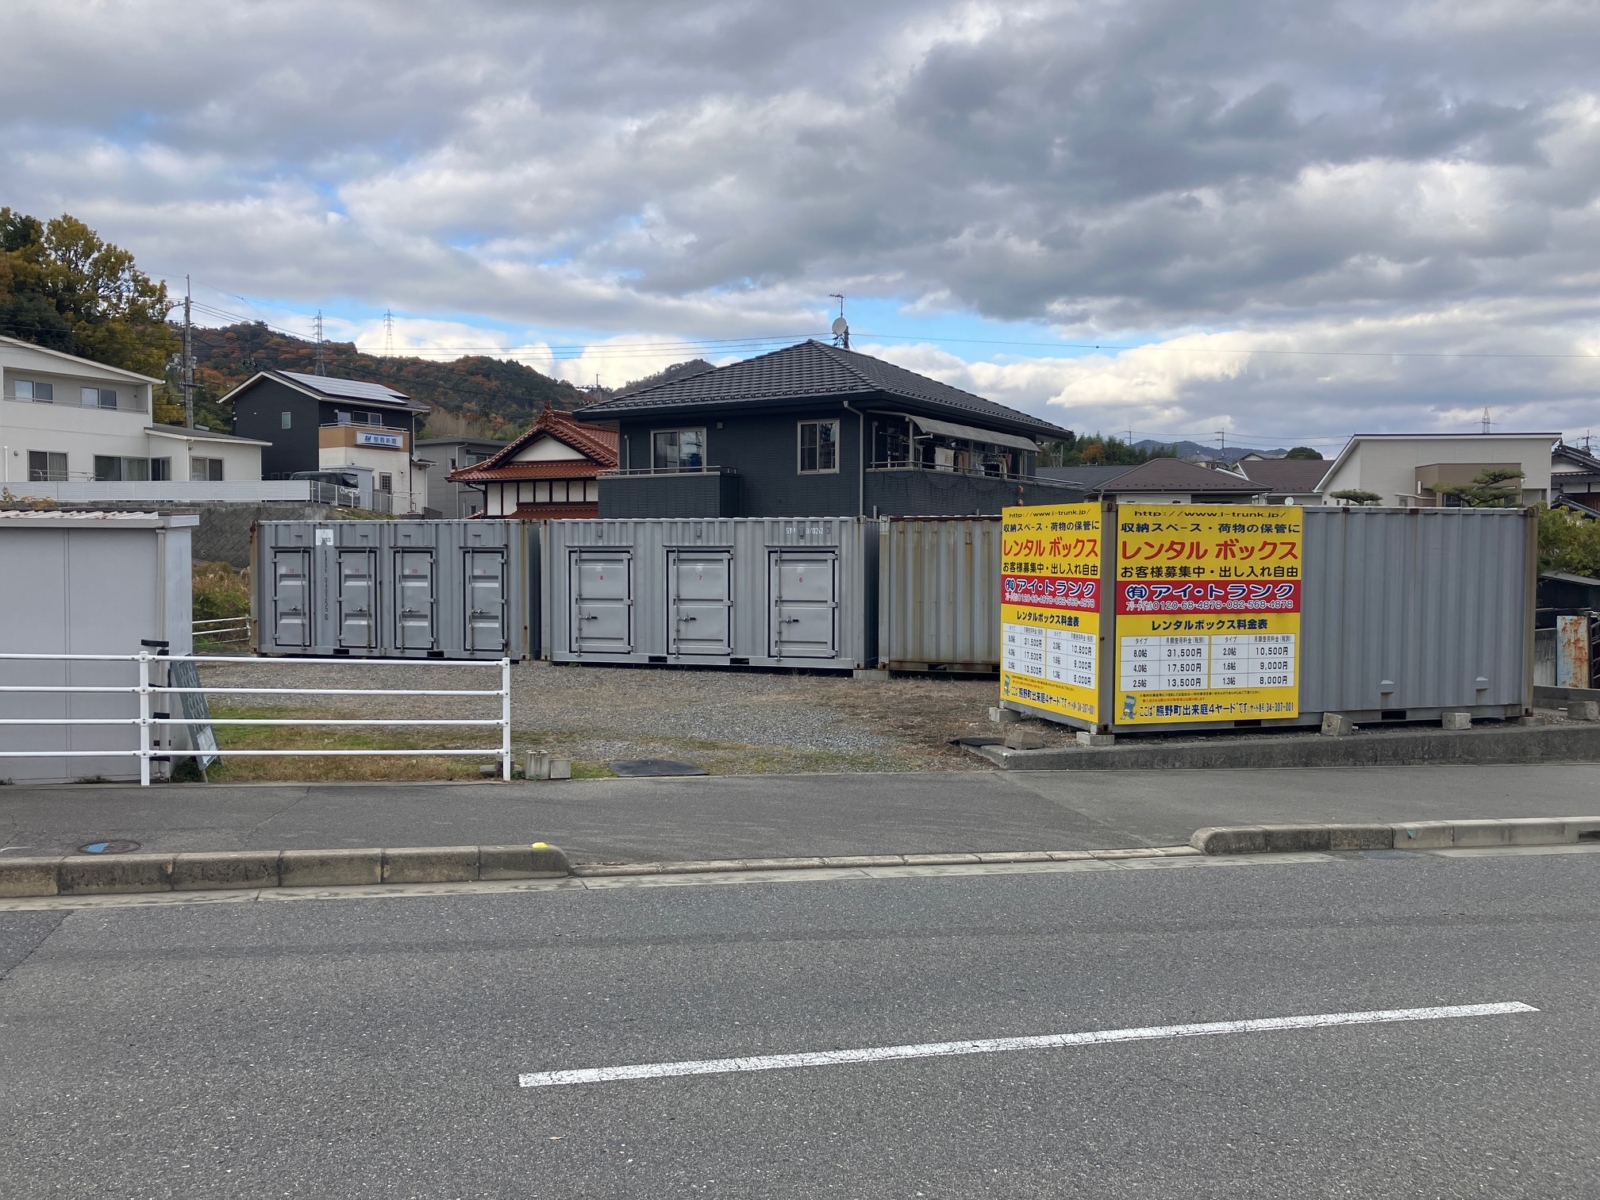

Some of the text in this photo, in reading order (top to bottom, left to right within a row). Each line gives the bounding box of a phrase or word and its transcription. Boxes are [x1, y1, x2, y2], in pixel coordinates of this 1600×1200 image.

[1122, 538, 1299, 561] レンタル ボックス
[1152, 618, 1268, 631] レンタルボックス料金表
[1167, 647, 1202, 658] 31,500円
[1255, 646, 1289, 656] 10,500円
[1167, 663, 1202, 672] 17,500円
[1259, 661, 1288, 670] 9,000円
[1167, 677, 1201, 687] 13,500円
[1259, 675, 1288, 685] 8,000円
